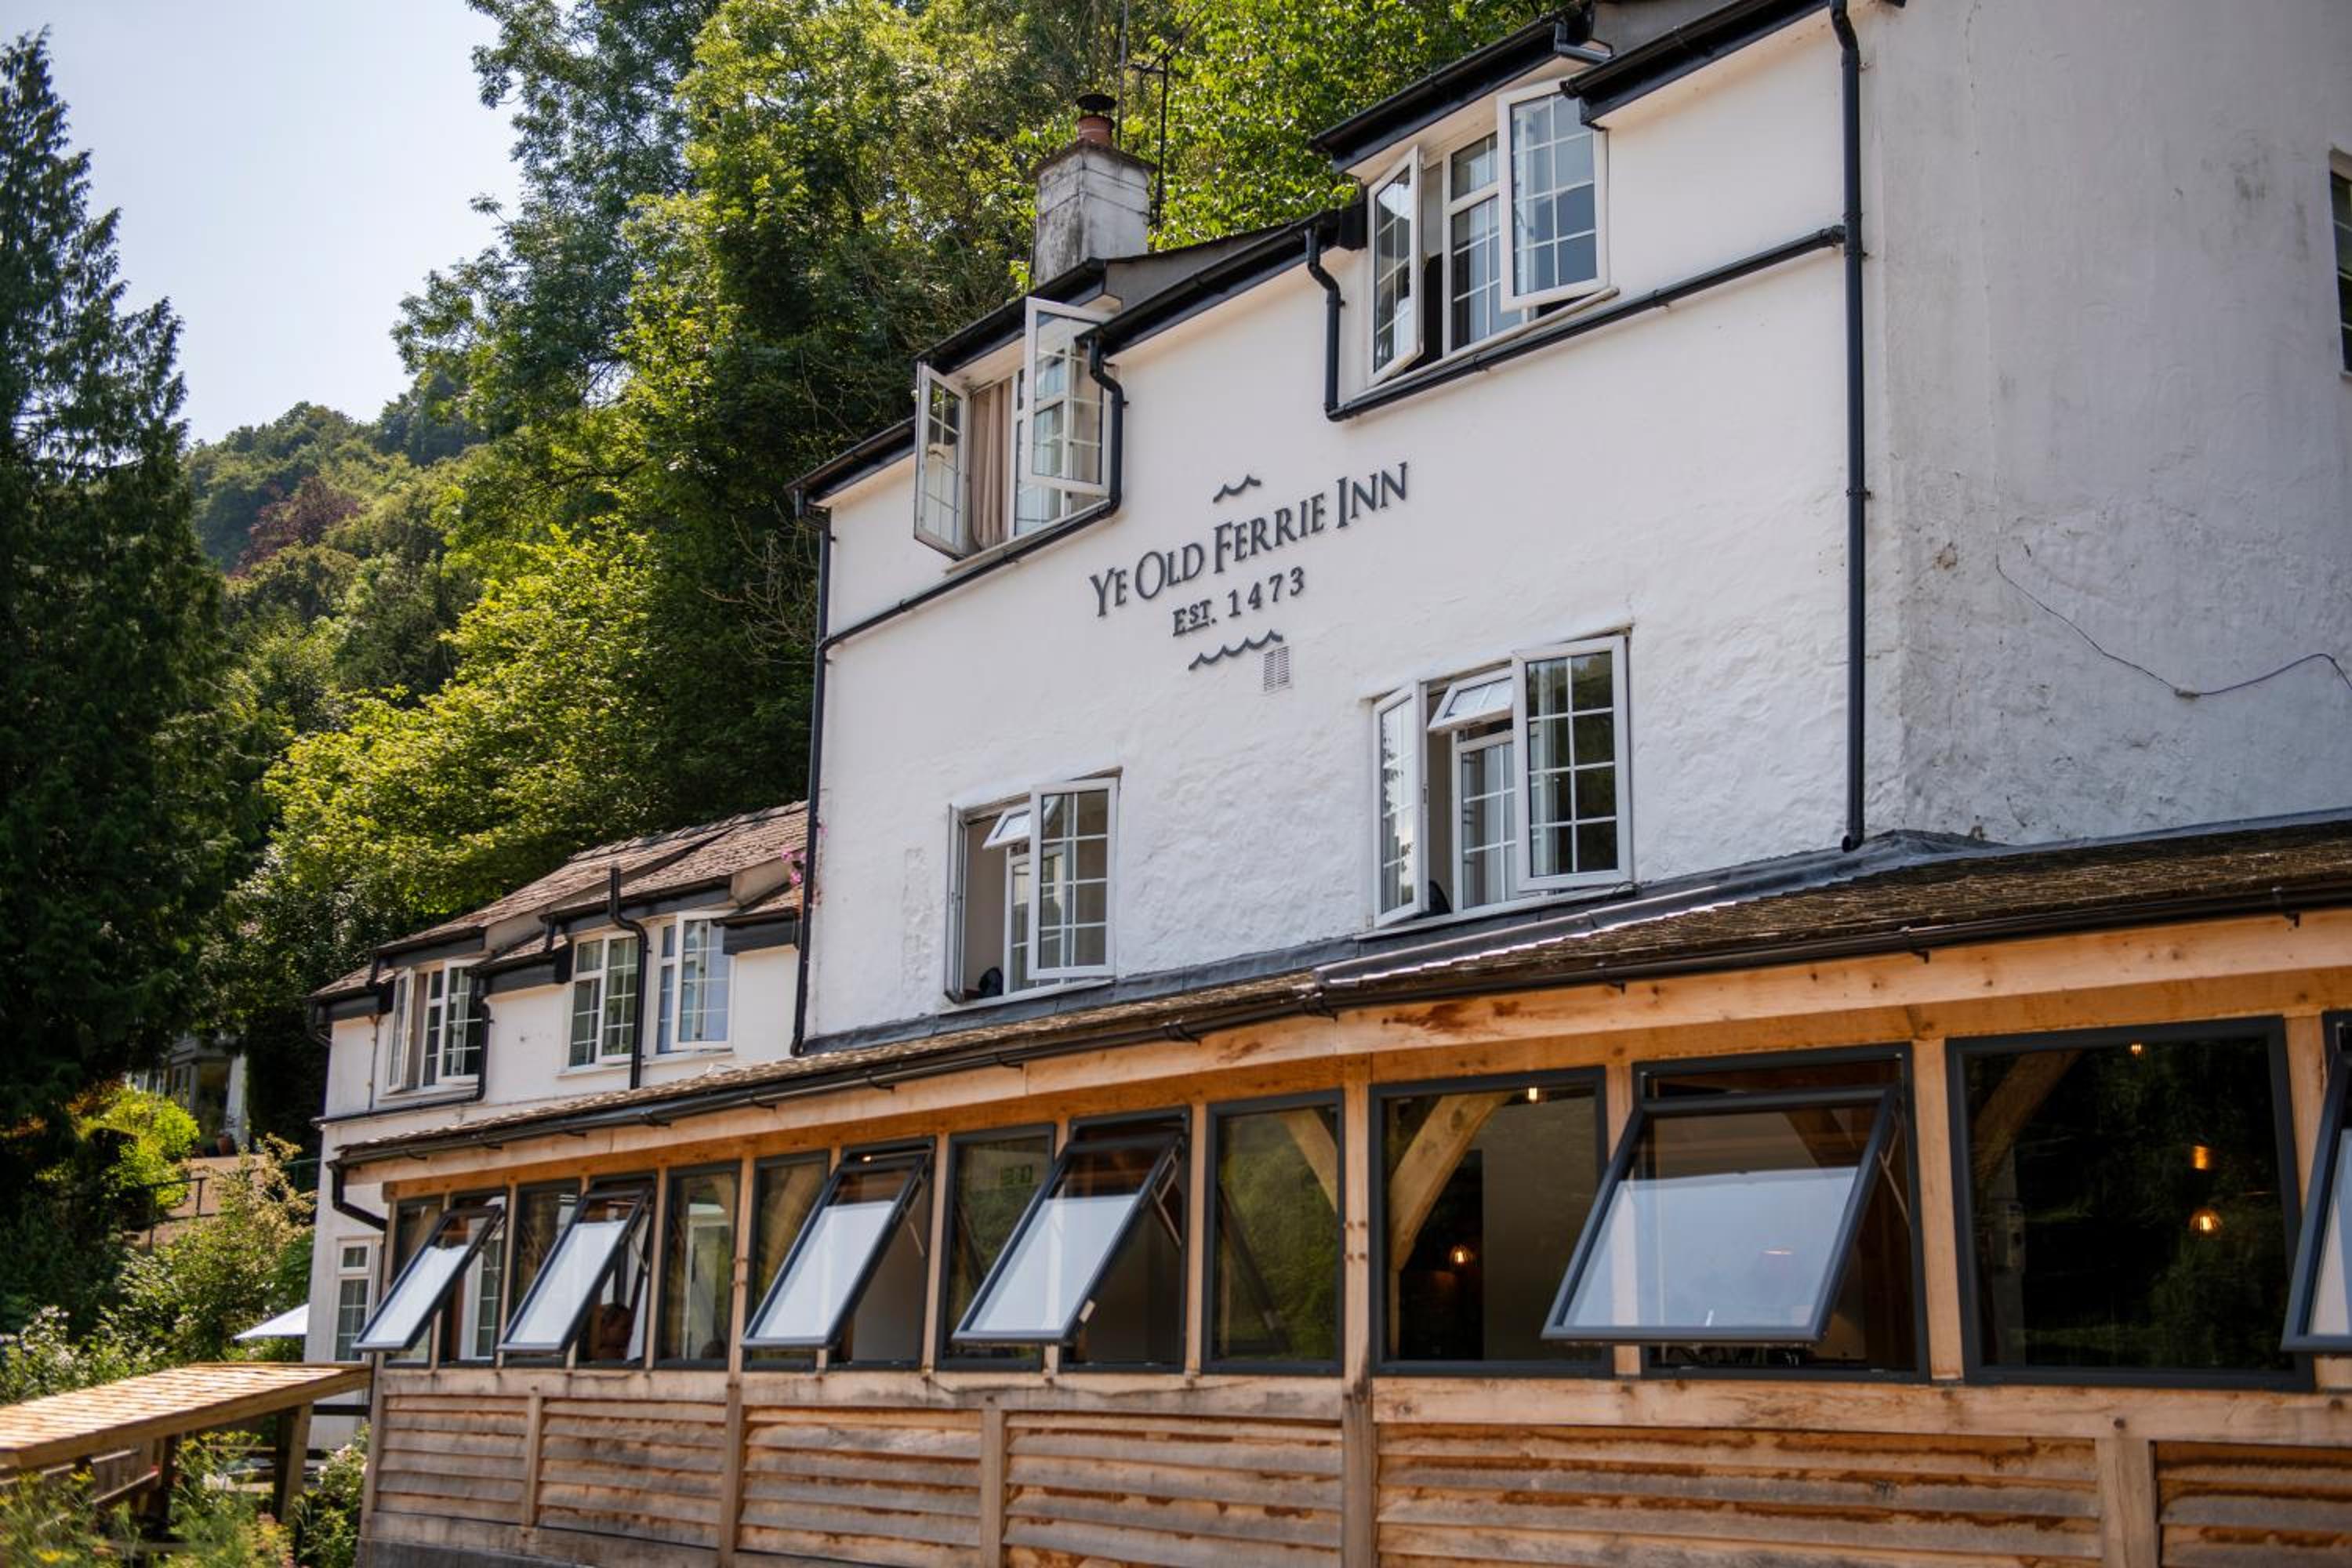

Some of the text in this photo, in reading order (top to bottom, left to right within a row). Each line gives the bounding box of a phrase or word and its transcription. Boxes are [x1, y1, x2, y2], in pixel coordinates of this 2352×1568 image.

[1090, 462, 1408, 617] YE OLD FERRIE INN
[1173, 567, 1305, 637] EST. 1473
